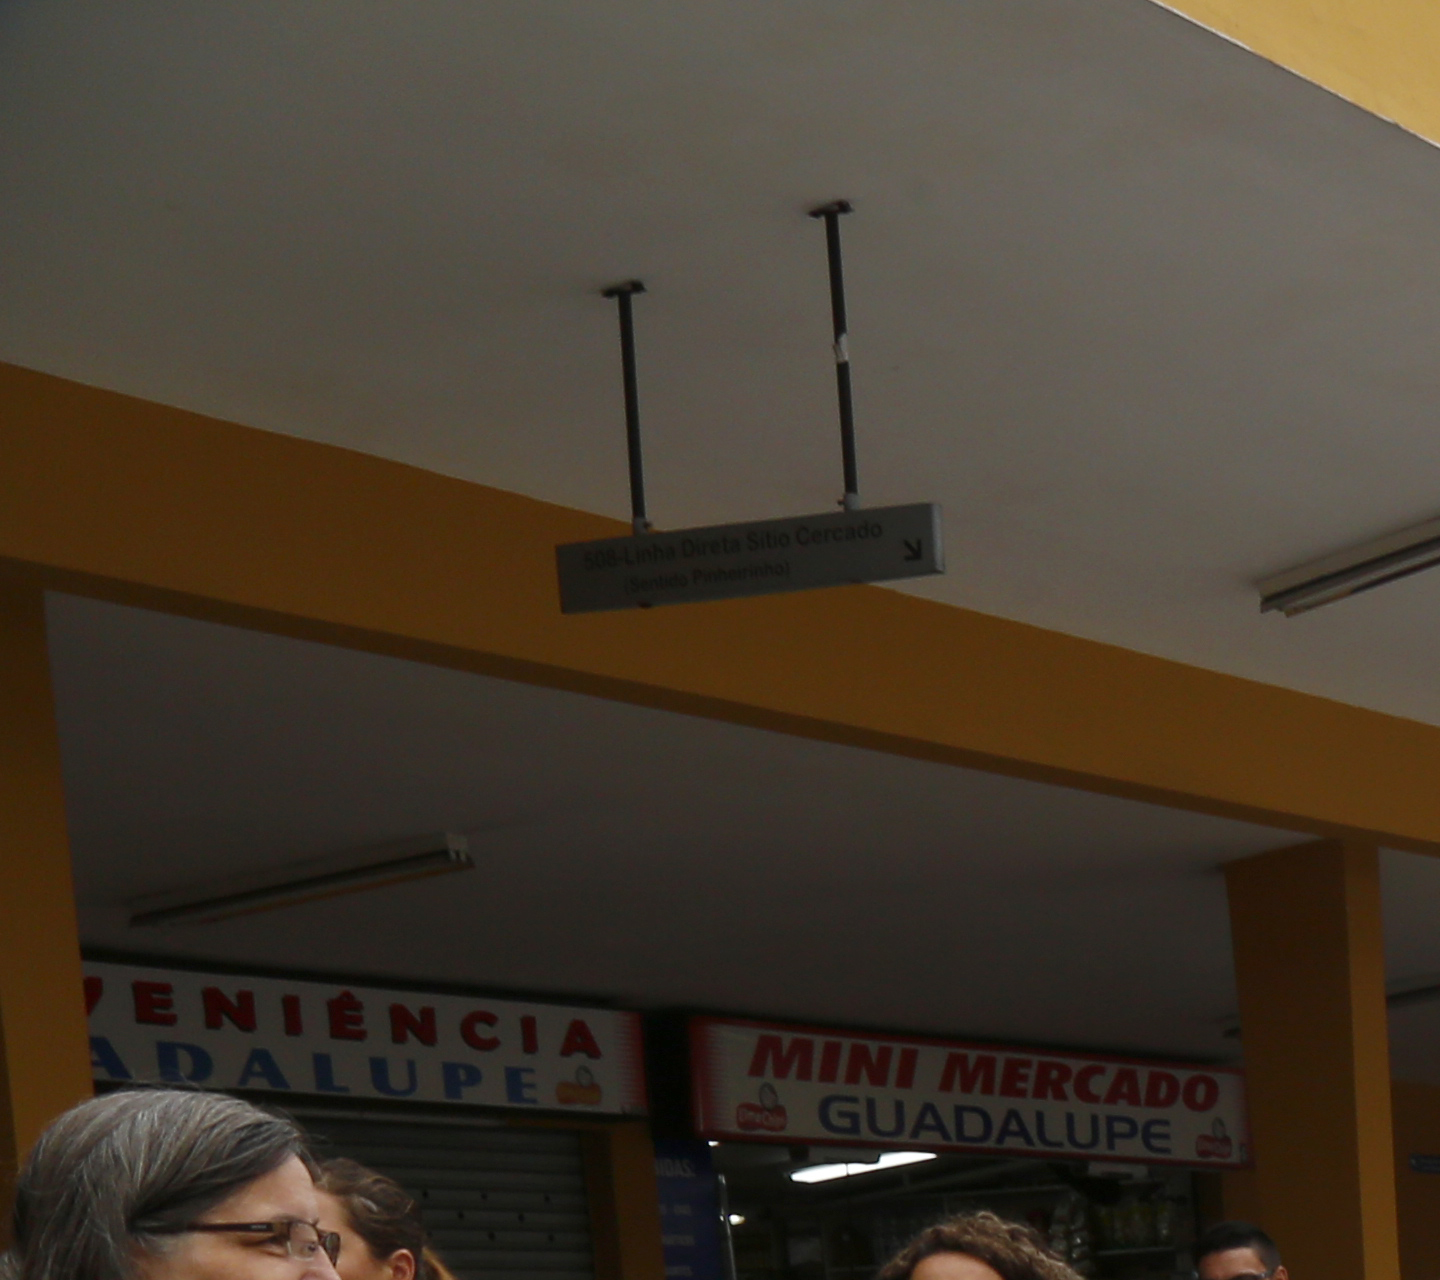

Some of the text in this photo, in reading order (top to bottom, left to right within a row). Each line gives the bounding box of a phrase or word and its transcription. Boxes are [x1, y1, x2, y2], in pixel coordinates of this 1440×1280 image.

[683, 533, 741, 558] Direta
[795, 519, 884, 547] Cercado
[748, 1034, 1220, 1112] MINI MERCADO
[818, 1094, 1173, 1155] GUADALUPE
